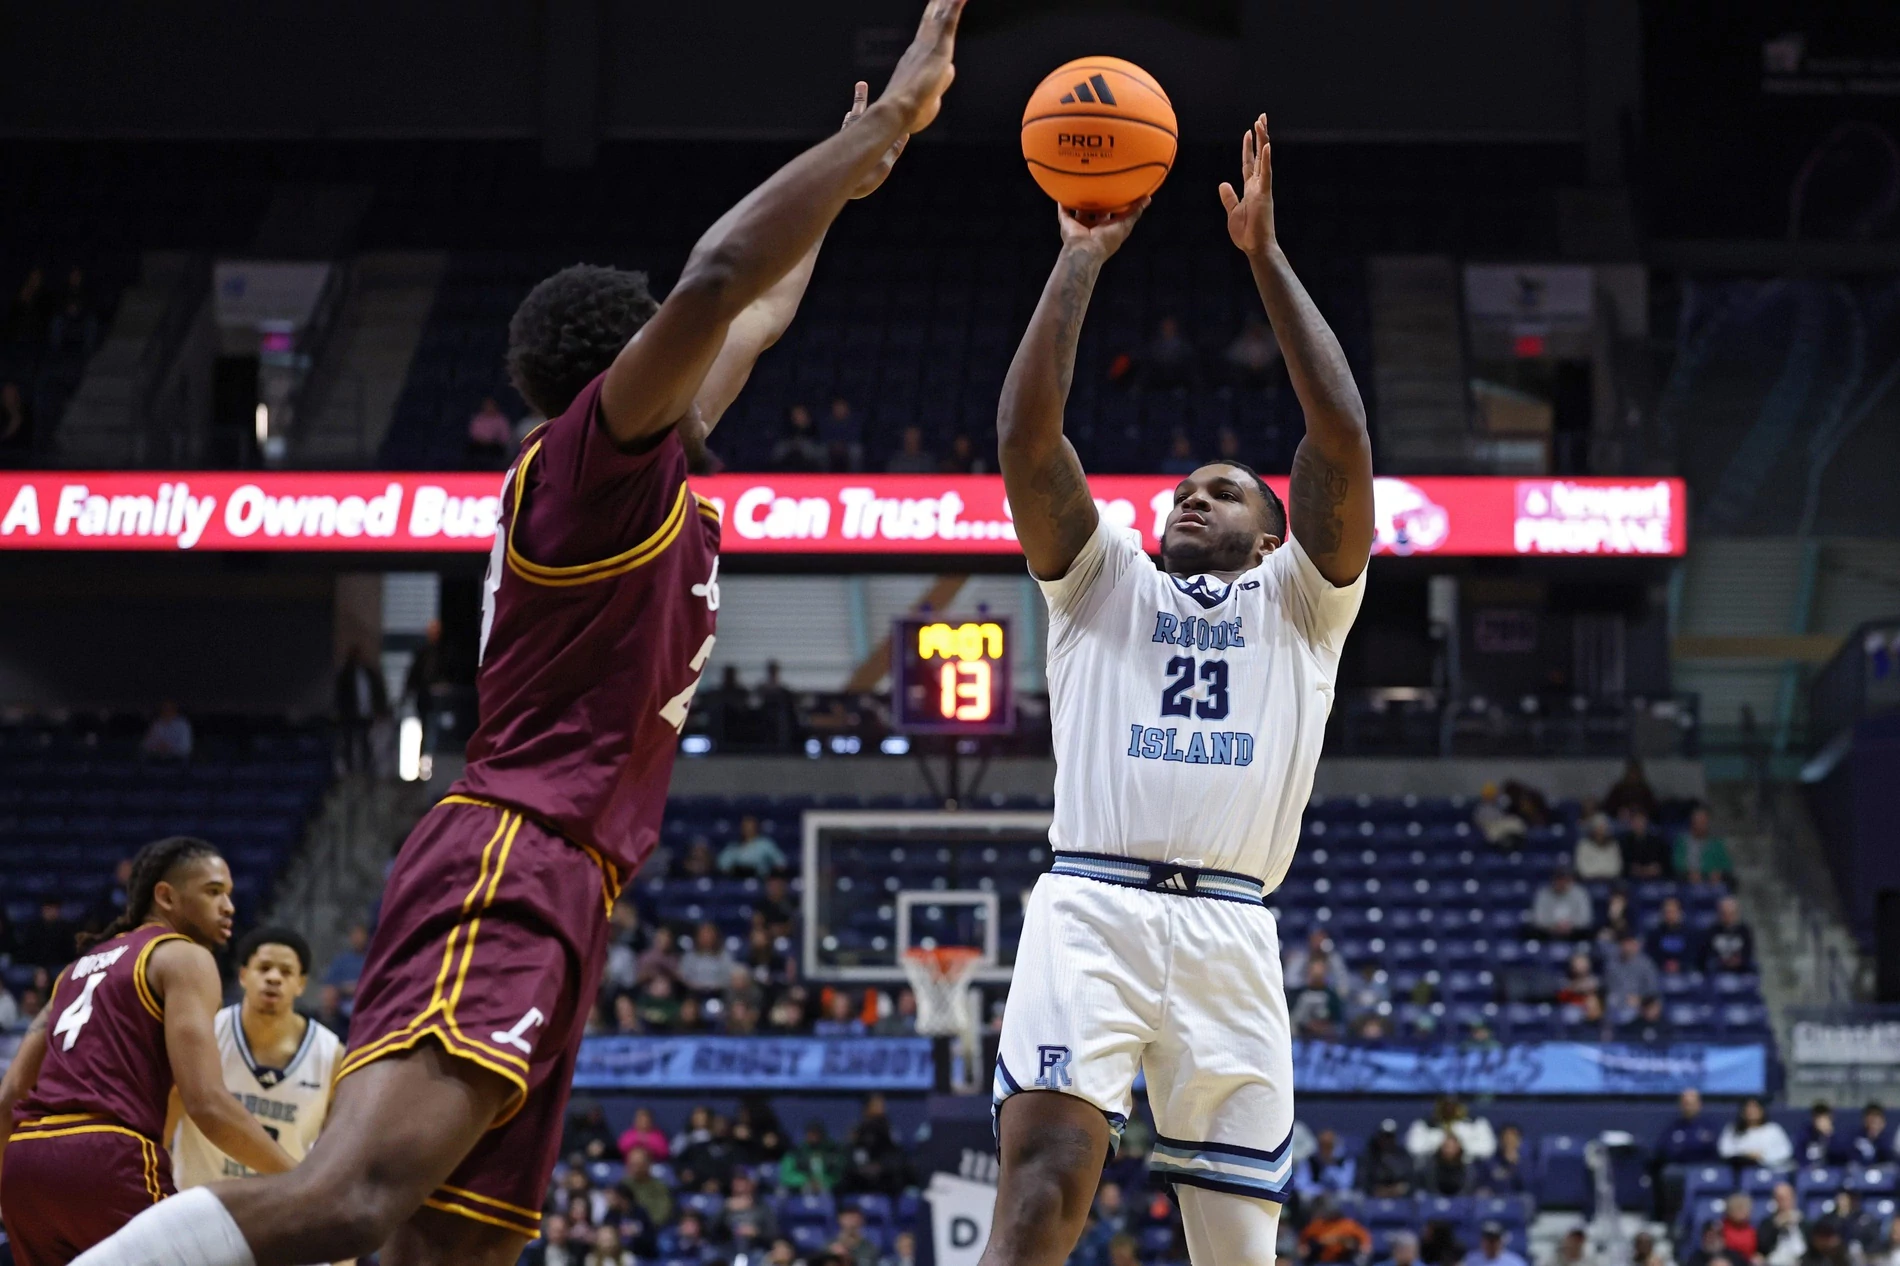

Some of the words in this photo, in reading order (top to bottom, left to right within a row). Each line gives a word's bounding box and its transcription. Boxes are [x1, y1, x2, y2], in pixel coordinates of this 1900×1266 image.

[1058, 133, 1102, 148] PRO
[1107, 135, 1115, 148] 1
[2, 486, 40, 535] A
[53, 484, 213, 549] Family
[224, 484, 402, 537] Owned
[733, 486, 831, 540] Can
[1152, 611, 1245, 651] RHODE
[941, 661, 991, 720] 13
[1160, 655, 1231, 721] 23
[1128, 724, 1254, 766] ISLAND
[53, 972, 107, 1052] 4
